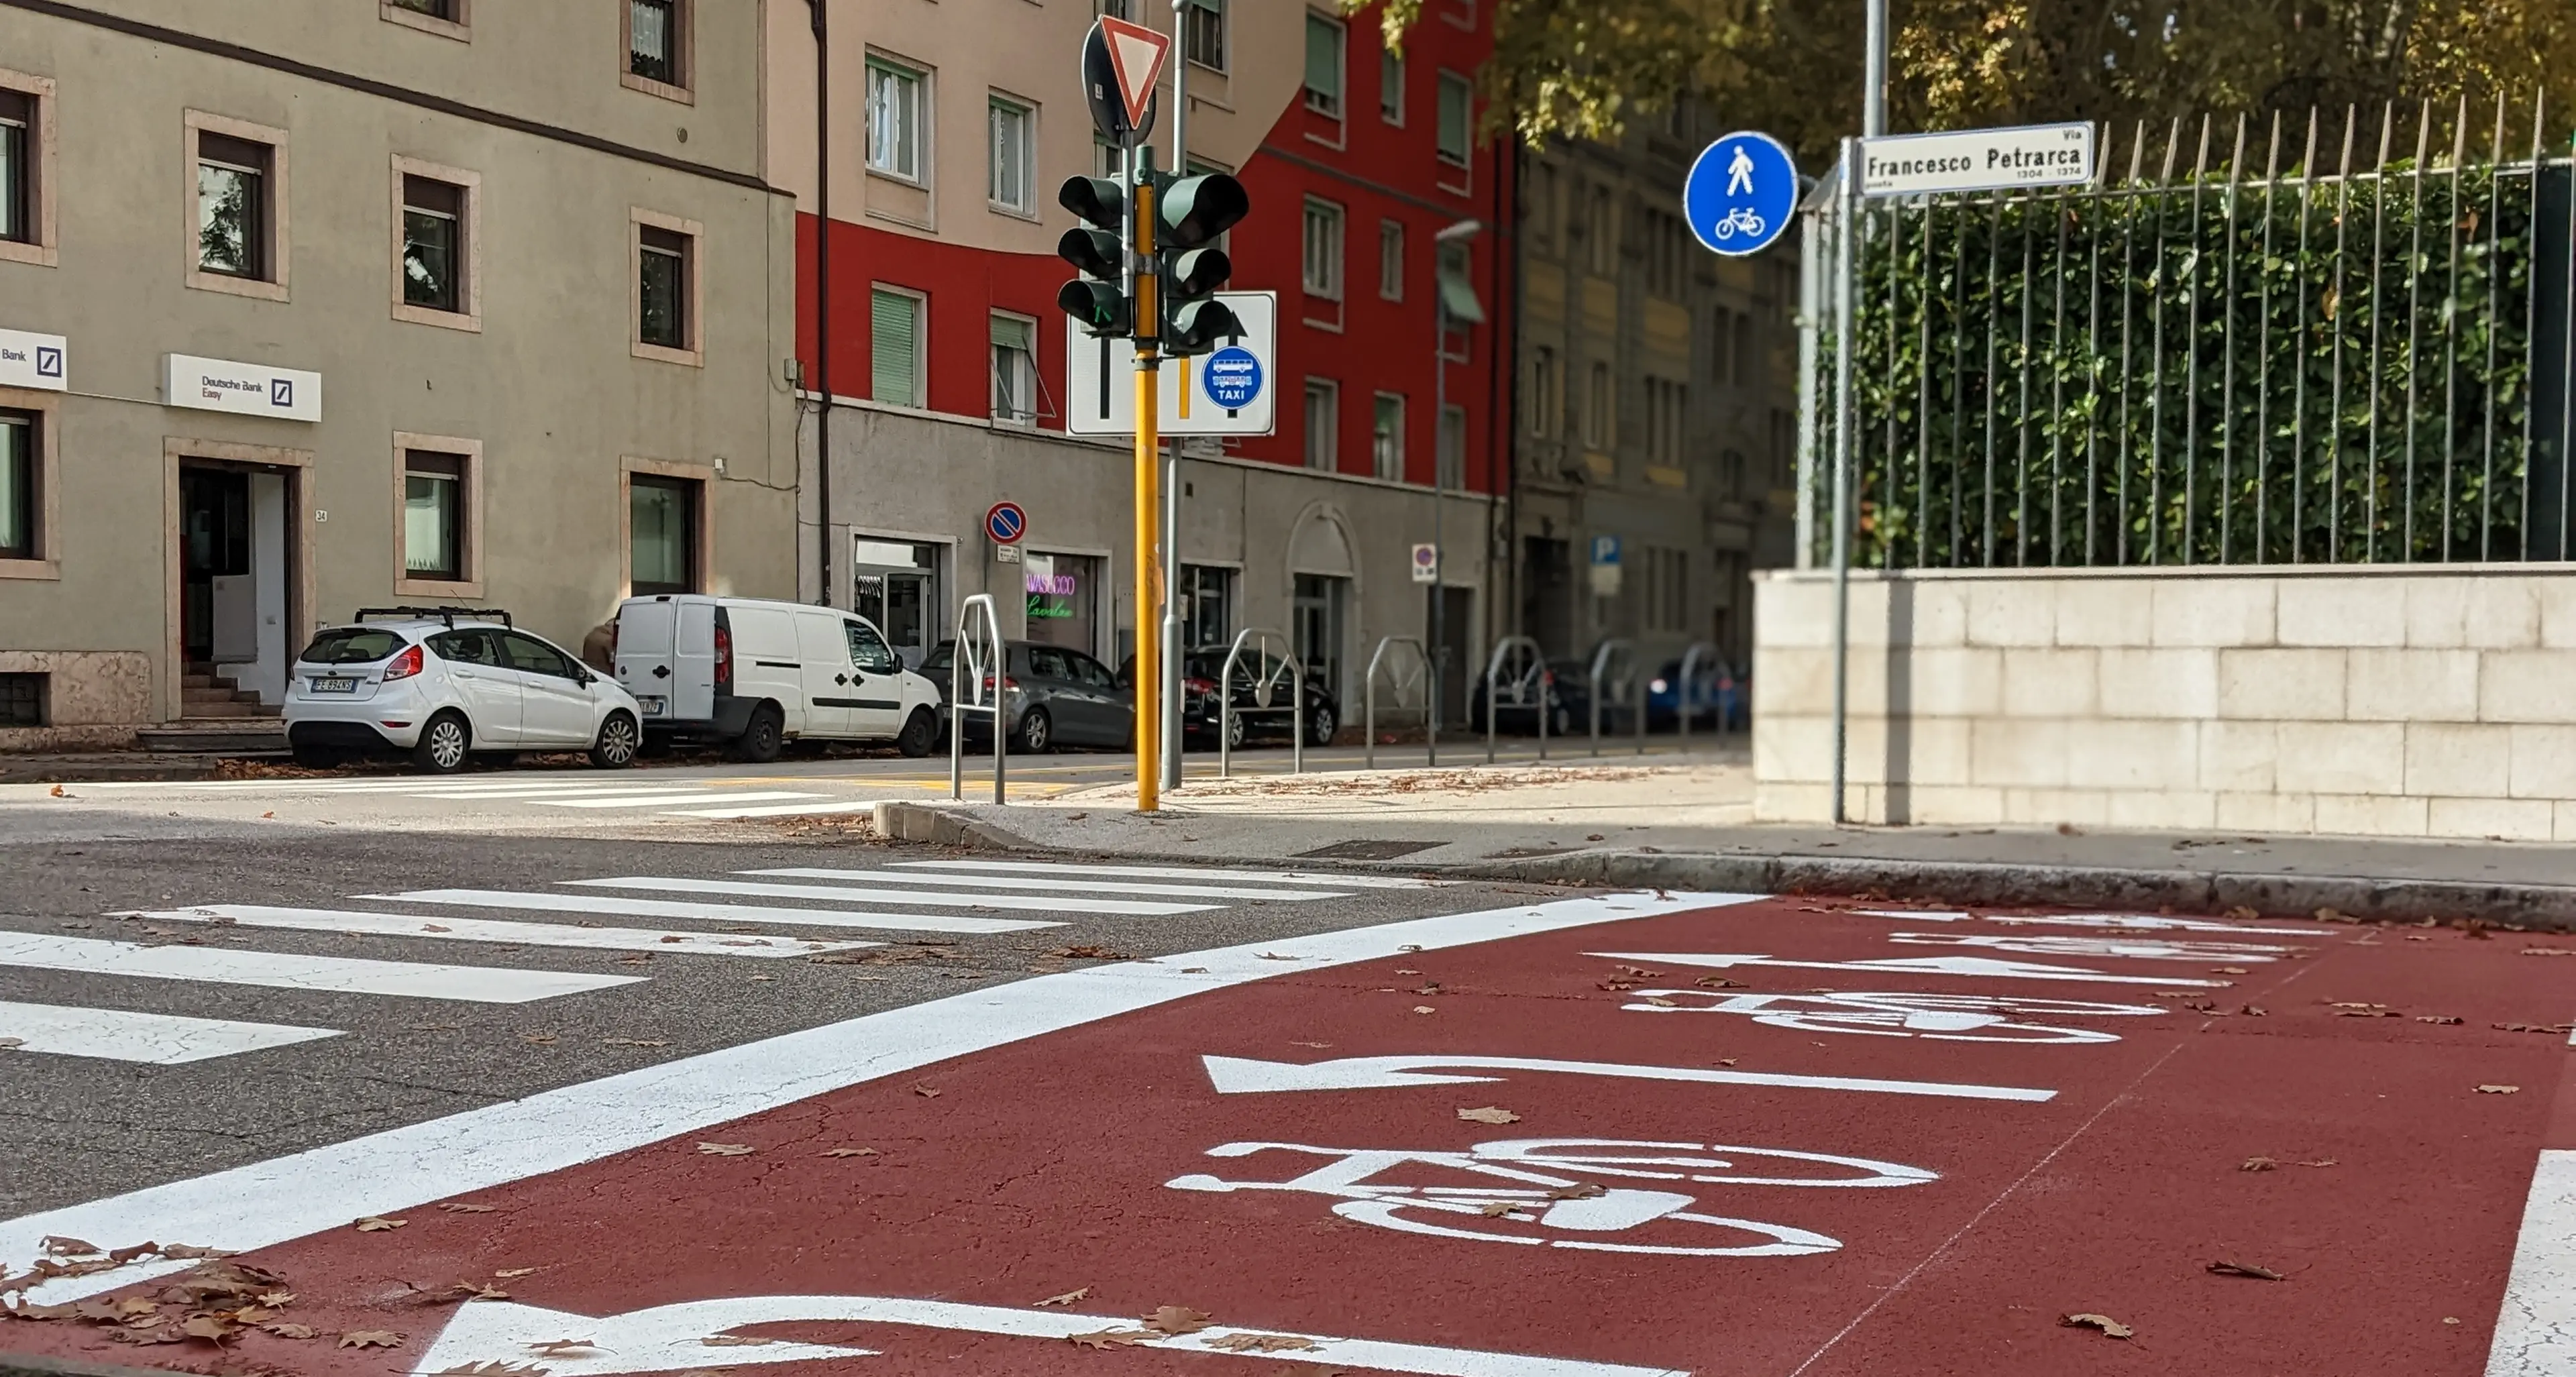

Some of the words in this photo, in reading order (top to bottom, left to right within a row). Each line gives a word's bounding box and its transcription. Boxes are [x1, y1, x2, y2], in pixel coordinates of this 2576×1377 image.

[2063, 129, 2082, 140] Via
[1869, 157, 1971, 176] Francesco
[1986, 147, 2081, 168] Petrarca
[2017, 169, 2043, 178] 1304
[2056, 167, 2081, 176] 1374
[2, 348, 26, 362] Bank
[202, 376, 240, 390] Deutsche
[242, 380, 262, 392] Bank
[202, 388, 222, 401] Easy
[1218, 390, 1245, 400] TAXI
[317, 511, 325, 520] 34
